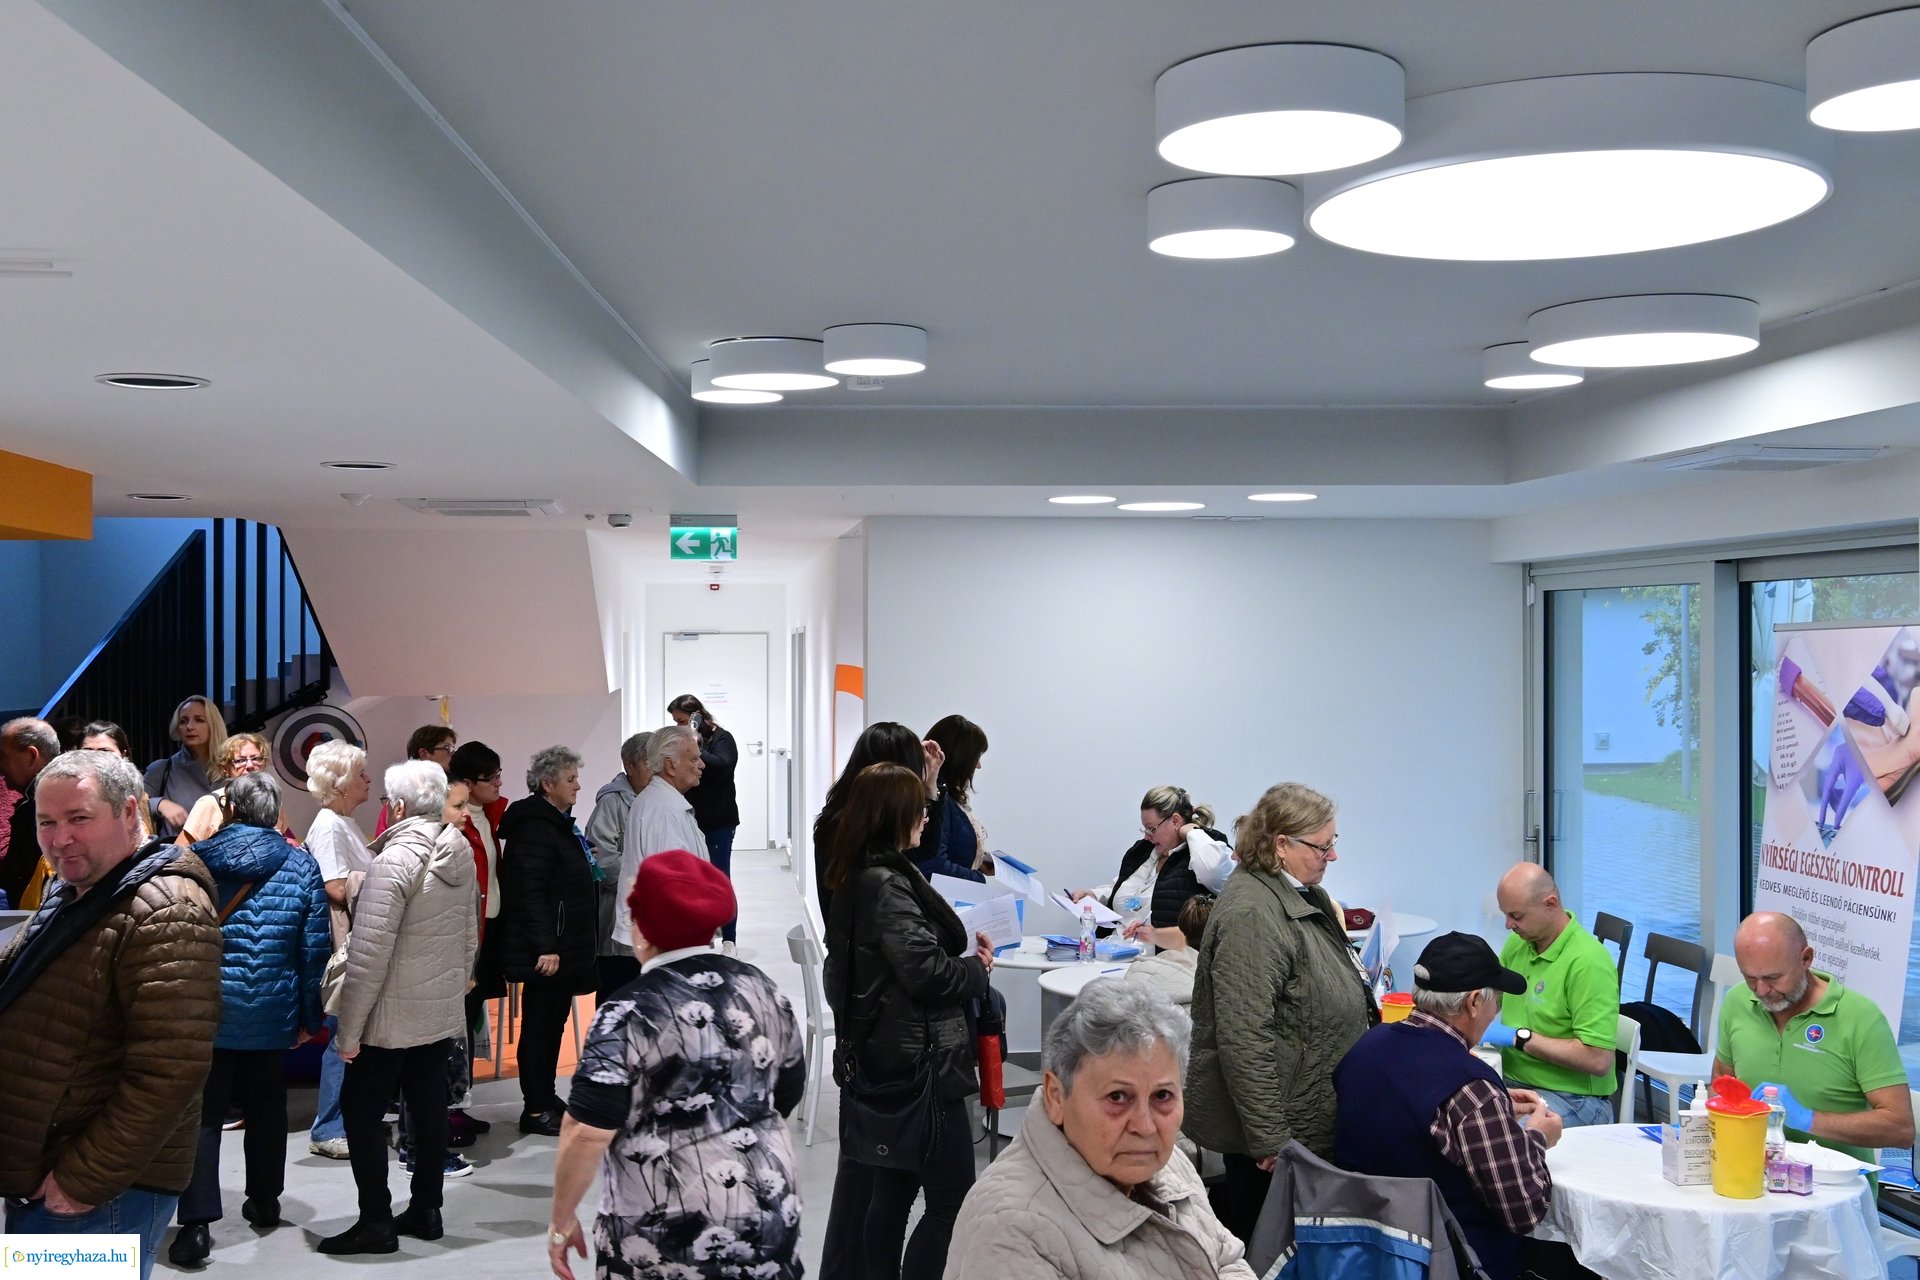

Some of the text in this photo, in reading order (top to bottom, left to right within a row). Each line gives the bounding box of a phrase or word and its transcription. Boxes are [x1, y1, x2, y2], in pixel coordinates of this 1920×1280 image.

[1761, 839, 1905, 898] NYÍRSÉGI EGÉSZSÉG KONTROLL
[1759, 878, 1781, 894] KEDVES
[1782, 884, 1810, 901] MEGLÉVŐ
[1811, 889, 1819, 904] ÉS
